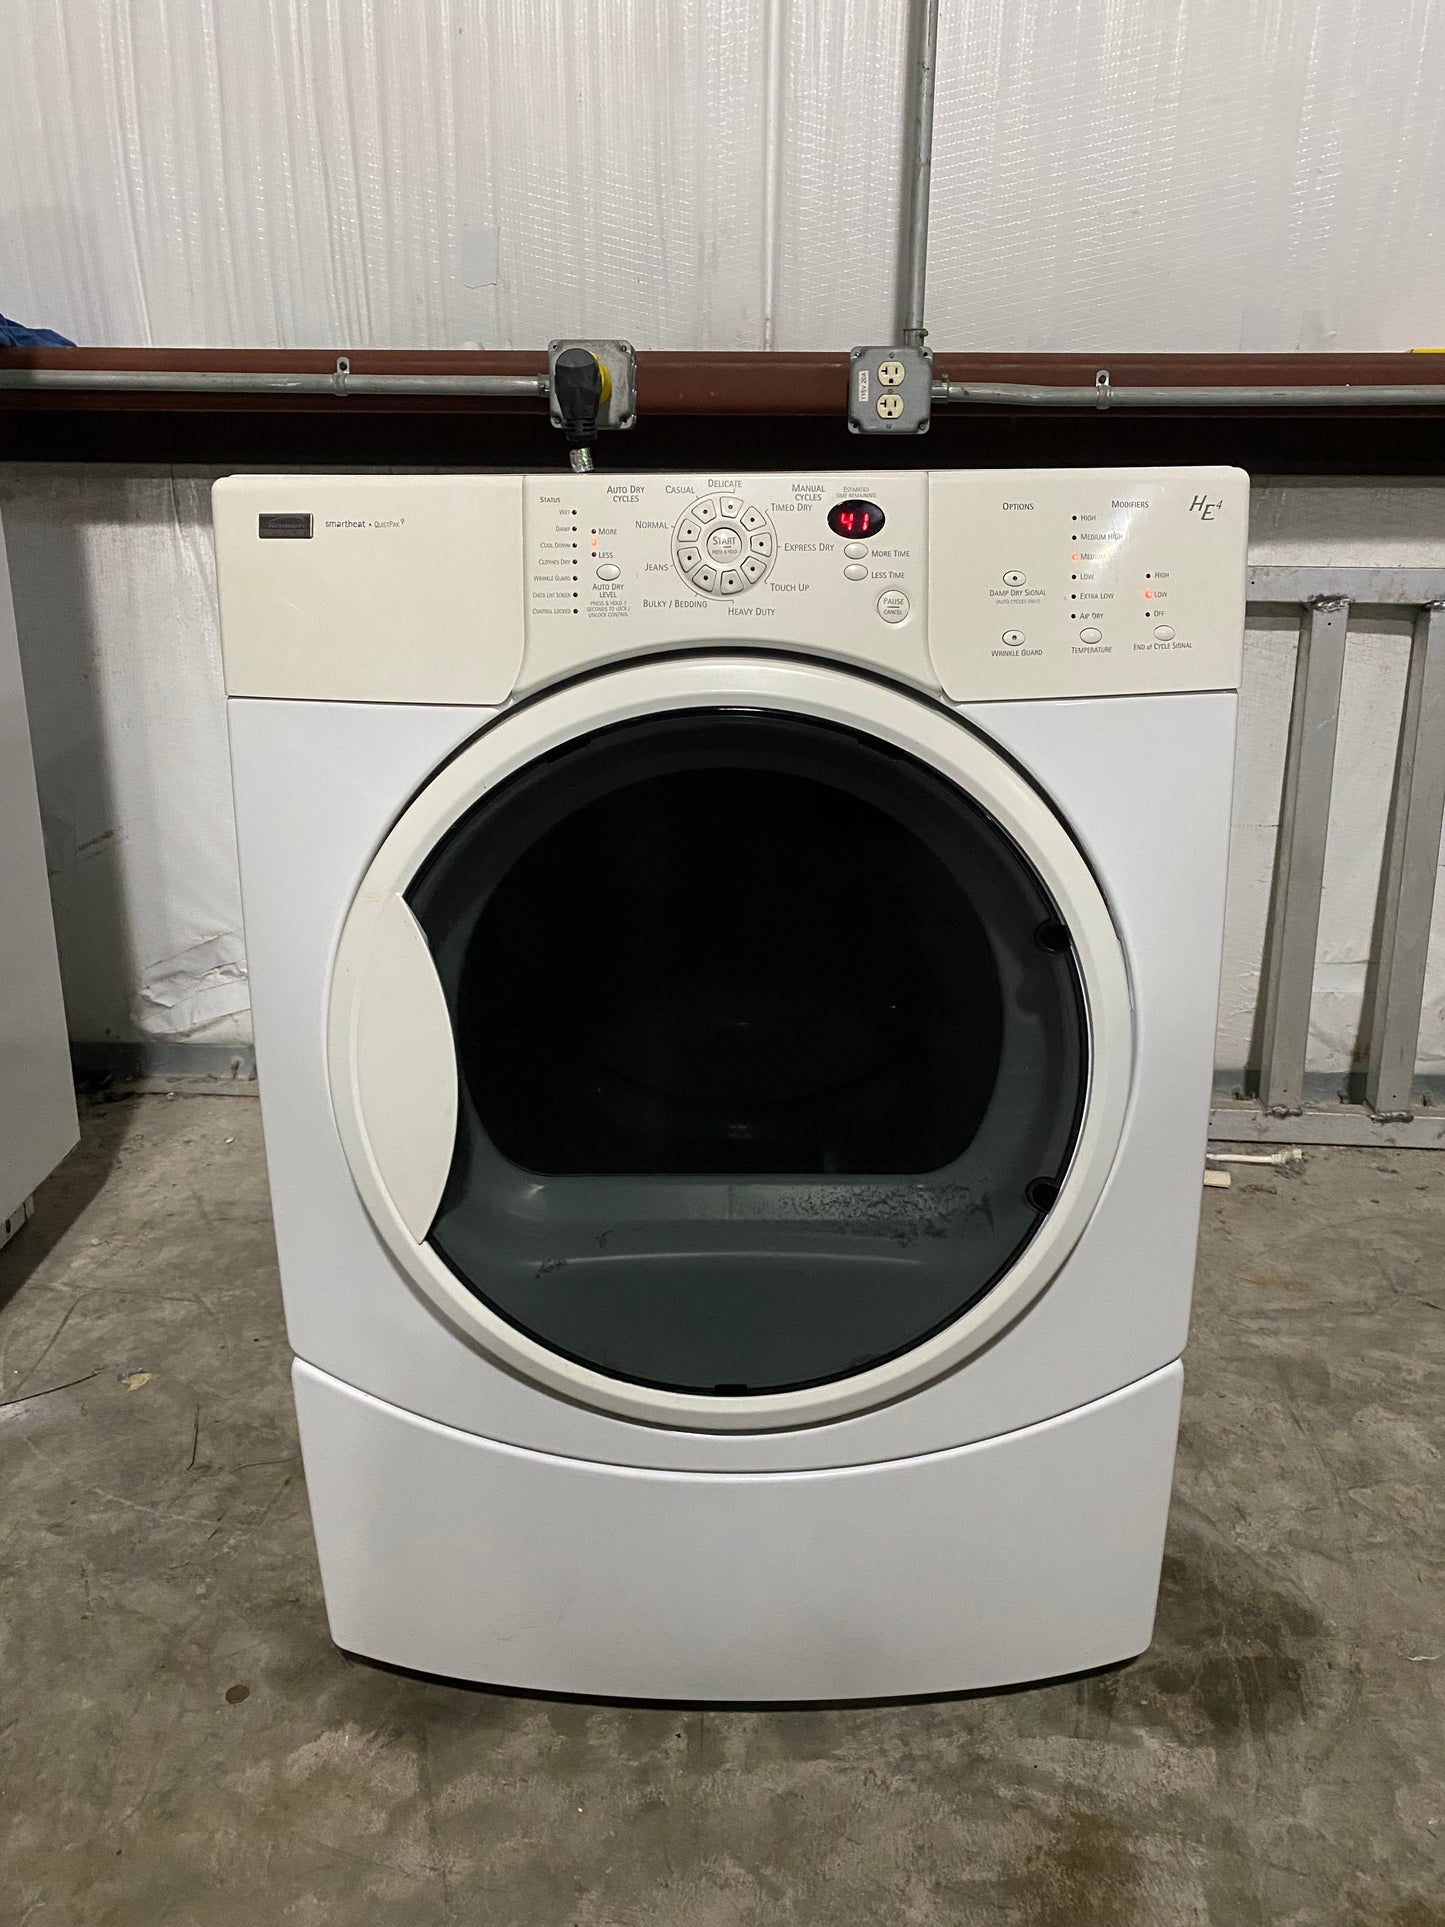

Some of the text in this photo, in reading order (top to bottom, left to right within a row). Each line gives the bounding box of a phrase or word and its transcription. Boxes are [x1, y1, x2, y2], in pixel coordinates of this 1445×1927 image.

[708, 479, 742, 488] DELICATE
[791, 483, 826, 493] MANUAL
[607, 486, 645, 494] AUTO DRY
[665, 485, 695, 494] CASUAL
[613, 495, 640, 503] CYCLES
[795, 493, 822, 501] CYCLES
[771, 503, 813, 512] TIMED DRY
[1002, 502, 1034, 511] OPTIONS
[1111, 500, 1149, 509] MODIFIERS
[324, 519, 366, 528] smartheat
[635, 520, 669, 529] NORMAL
[839, 512, 870, 531] 41
[712, 536, 737, 545] START
[784, 542, 835, 551] EXPRESS DRY
[871, 550, 911, 558] MORE TIME
[645, 563, 669, 572] JEANS
[871, 571, 906, 579] LESS TIME
[1154, 571, 1170, 579] HIGH
[592, 583, 625, 591] AUTO DRY
[770, 582, 810, 592] TOUCH UP
[599, 591, 617, 599] LEVEL
[989, 588, 1047, 597] DAMP DRY SIGNAL
[1080, 592, 1115, 600] EXTRA LOW
[643, 599, 667, 608] BULKY
[674, 599, 708, 609] BEDDING
[883, 597, 904, 606] PAUSE
[727, 607, 776, 616] HEAVY DUTY
[1071, 646, 1112, 654] TEMPERATURE
[1133, 643, 1146, 651] END
[1172, 641, 1193, 650] SIGNAL
[991, 648, 1043, 657] WRINKLE GUARD
